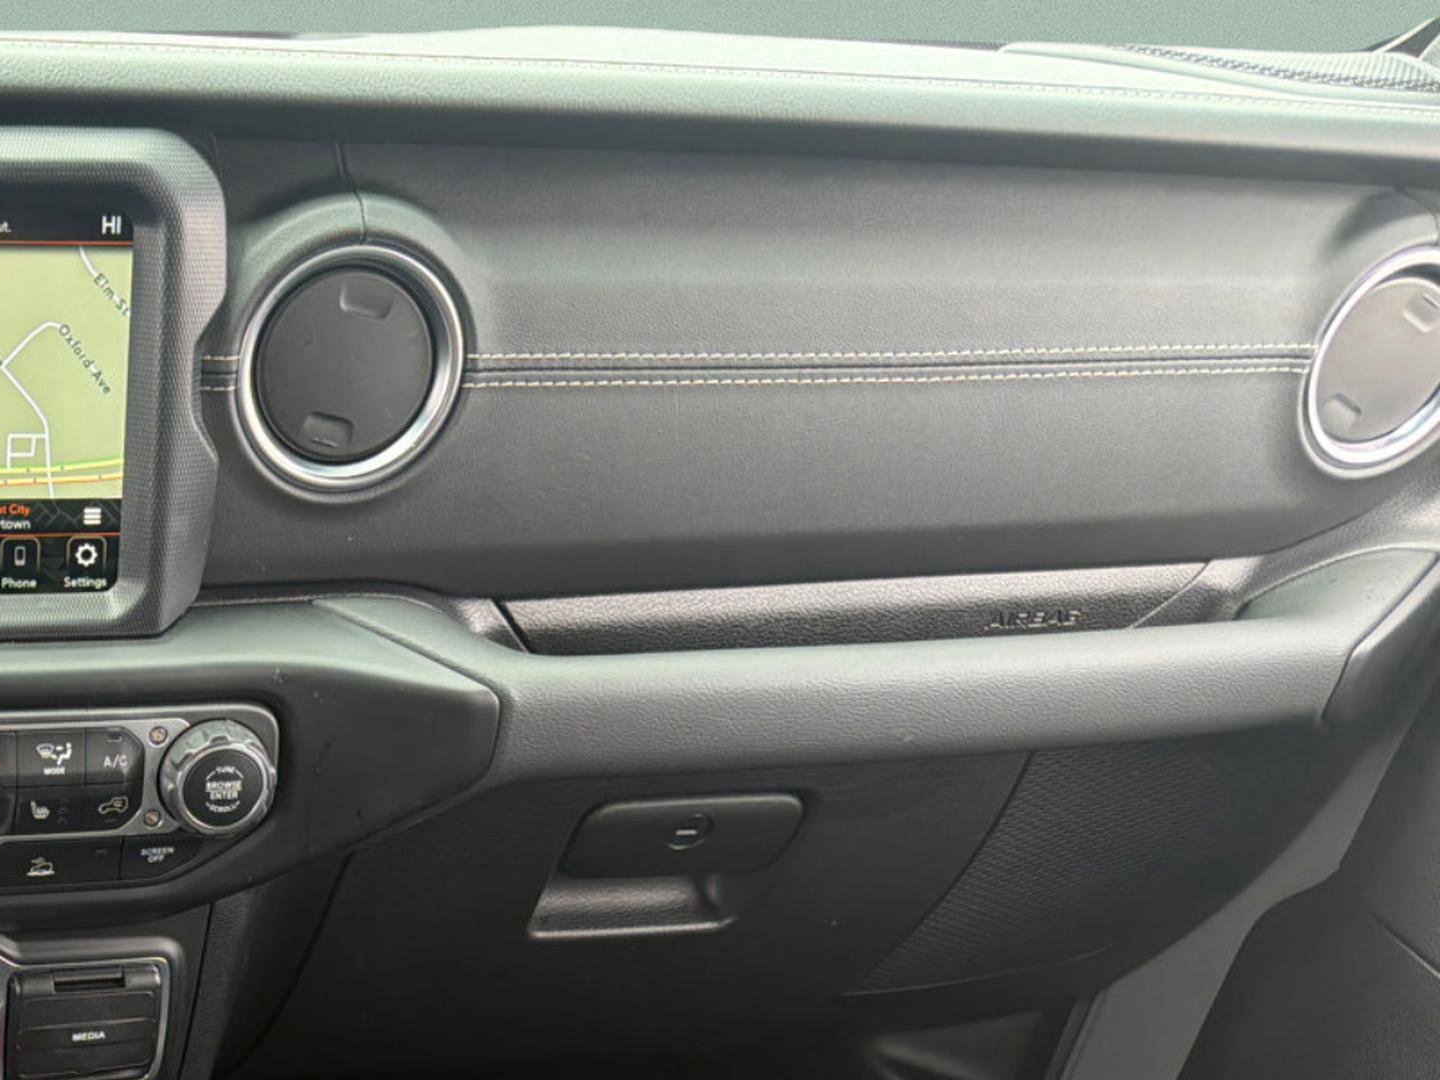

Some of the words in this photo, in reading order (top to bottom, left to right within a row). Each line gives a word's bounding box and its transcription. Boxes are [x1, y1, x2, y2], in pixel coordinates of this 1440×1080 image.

[101, 215, 122, 235] HI
[58, 323, 93, 369] Oxford
[92, 368, 111, 395] Ave
[9, 504, 32, 517] City
[1, 577, 37, 589] Phone
[64, 576, 107, 591] Settings
[102, 755, 128, 768] A/C
[72, 1030, 106, 1042] MEDIA
